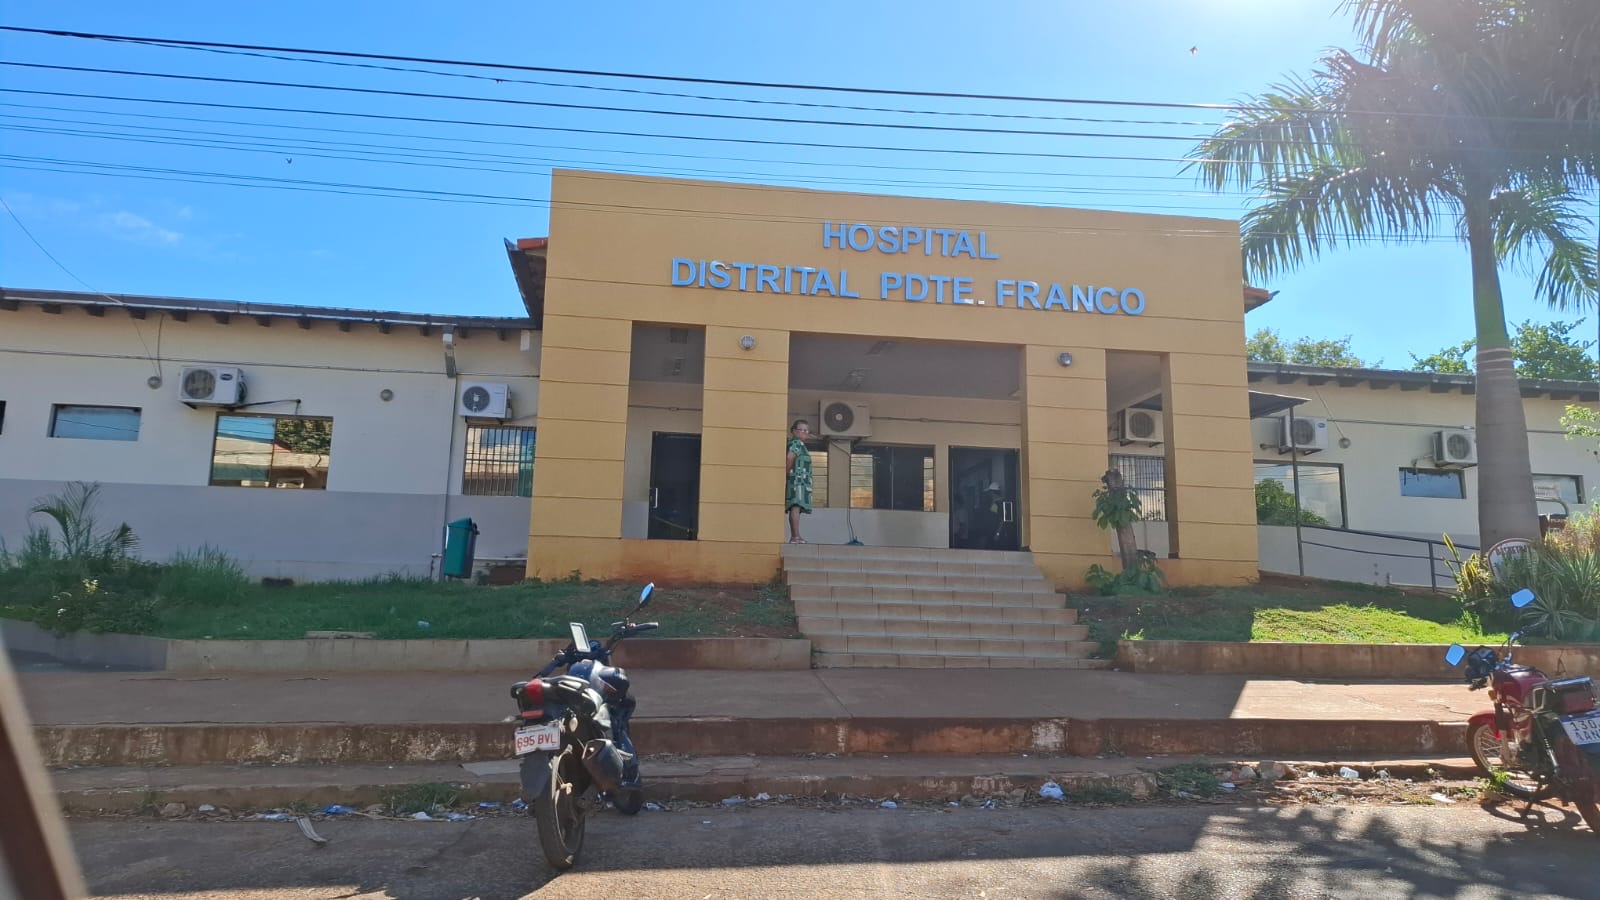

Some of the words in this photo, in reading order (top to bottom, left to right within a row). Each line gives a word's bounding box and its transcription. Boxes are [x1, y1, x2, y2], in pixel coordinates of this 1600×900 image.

[823, 220, 999, 260] HOSPITAL
[671, 257, 860, 298] DISTRITAL
[880, 271, 986, 305] PDTE.
[996, 278, 1146, 316] FRANCO
[1570, 719, 1600, 731] 130
[517, 735, 536, 749] 695
[537, 733, 557, 745] BVL
